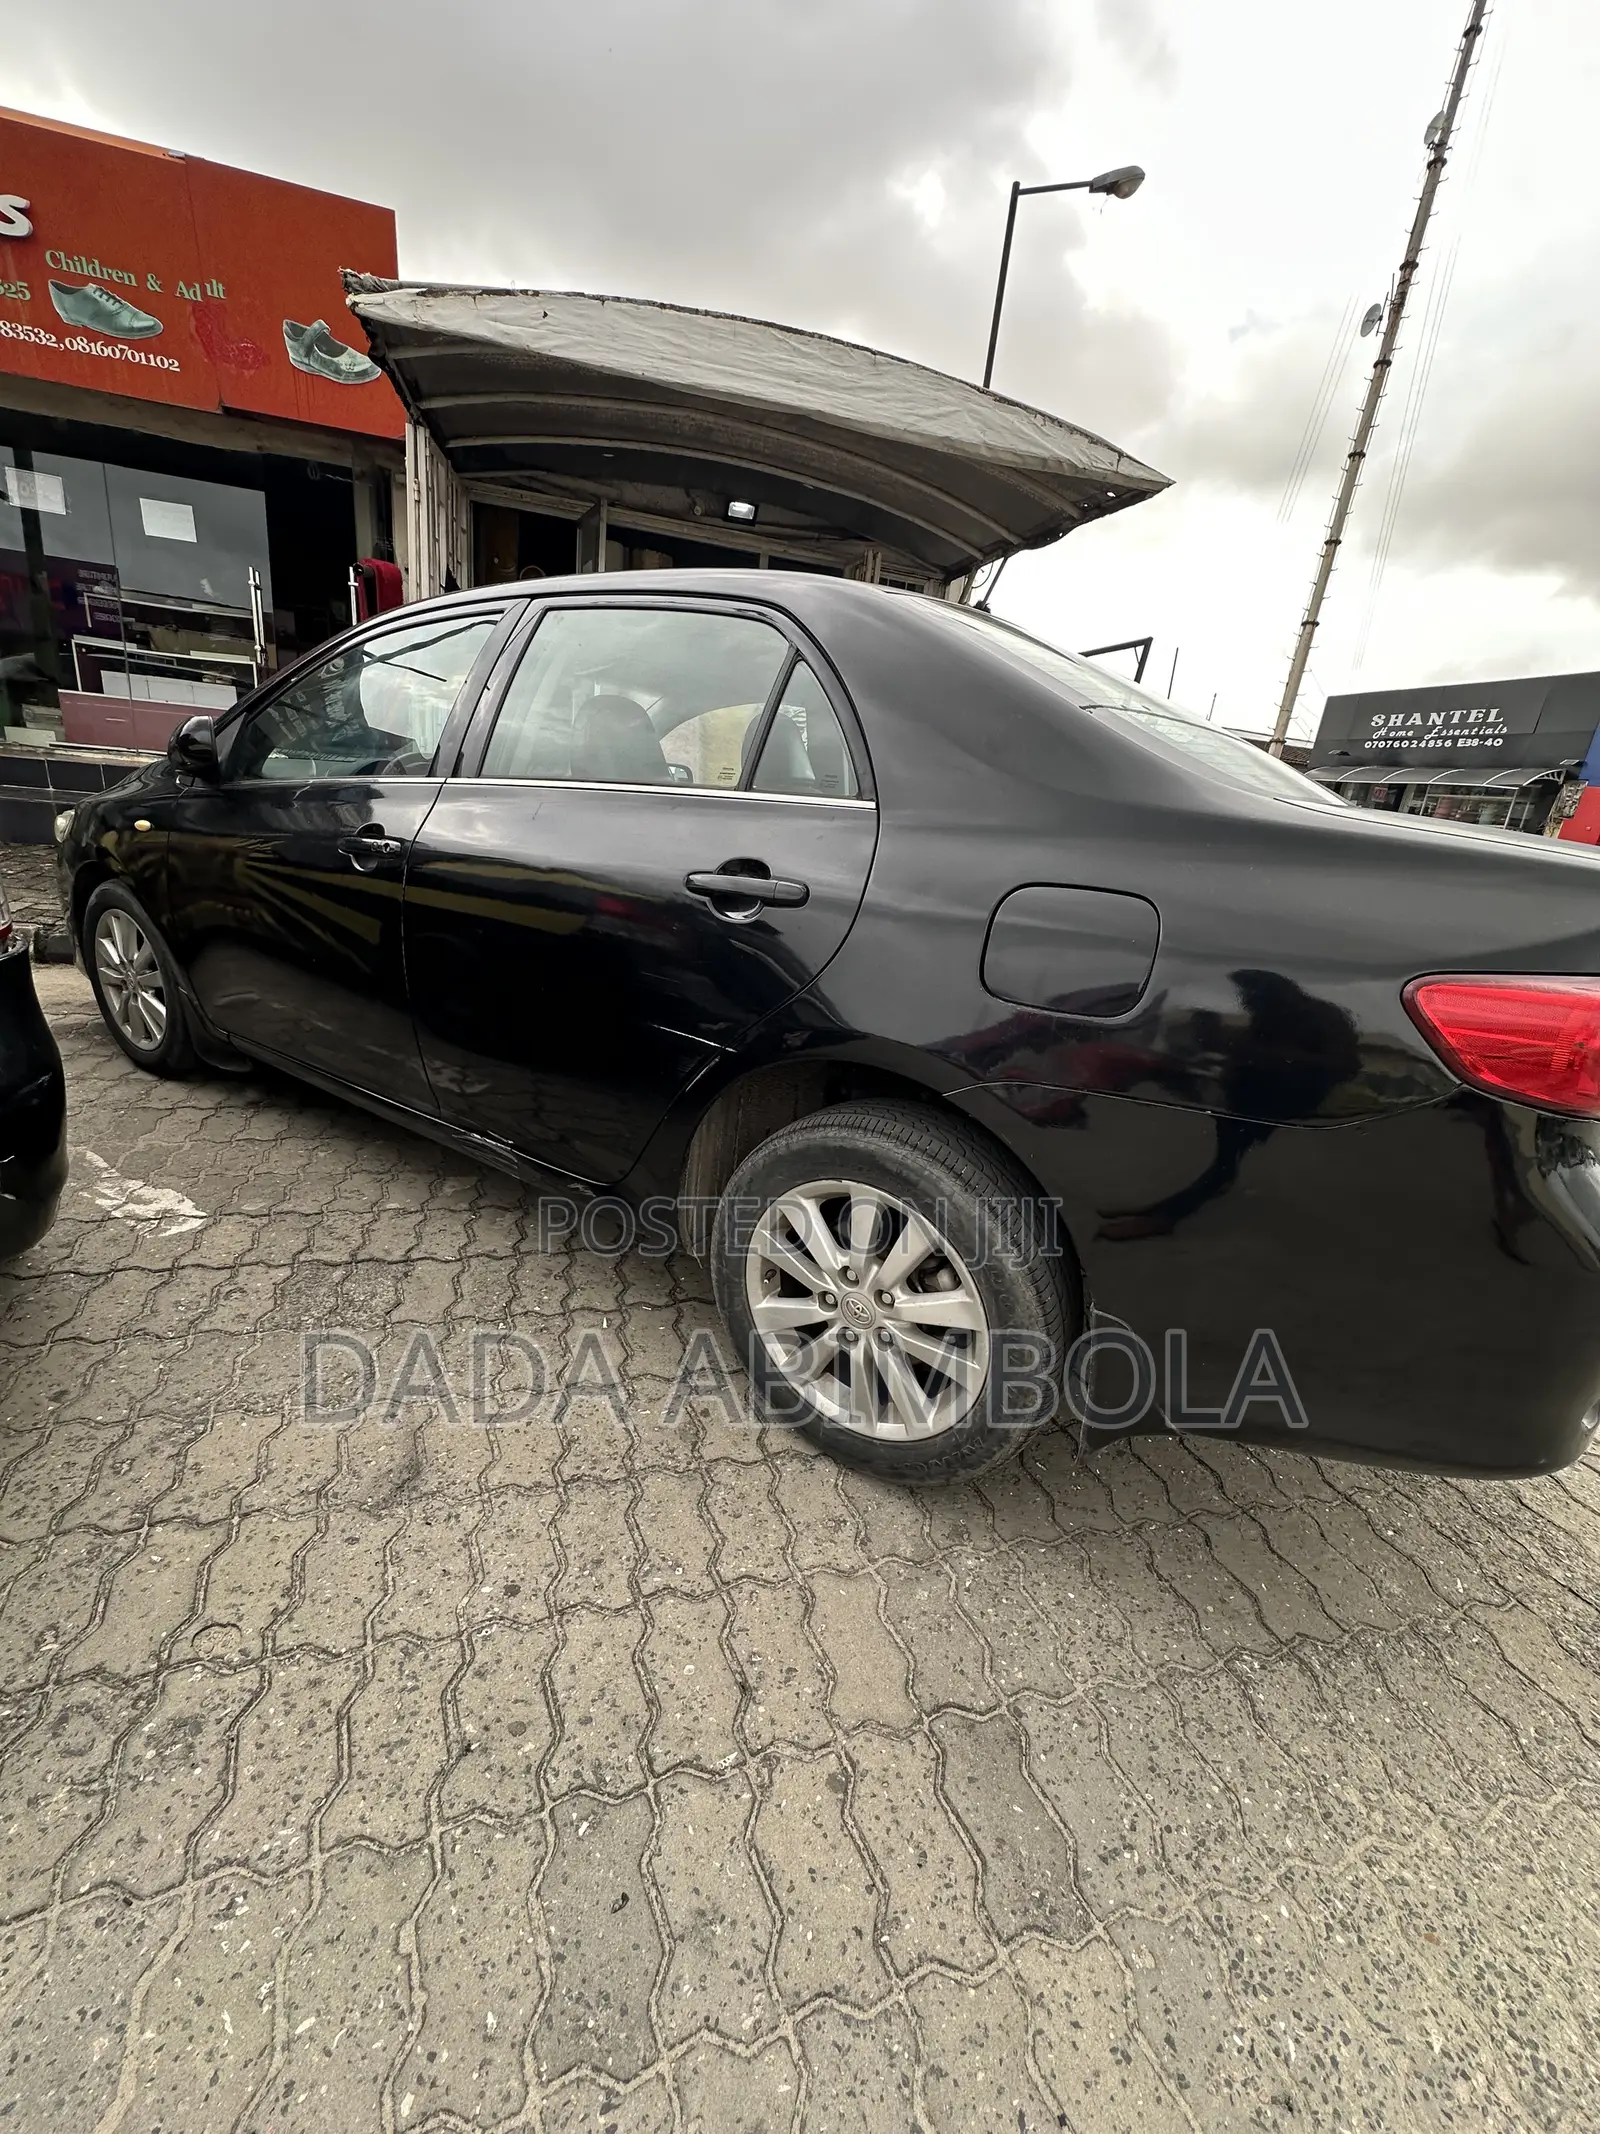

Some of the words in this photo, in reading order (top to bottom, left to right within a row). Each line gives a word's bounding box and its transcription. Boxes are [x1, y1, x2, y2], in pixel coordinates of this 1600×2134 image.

[45, 249, 138, 287] Children
[146, 272, 164, 293] &
[1371, 708, 1503, 726] SHANTEL
[1372, 726, 1415, 739] Home
[1424, 724, 1507, 739] Essentials
[1364, 738, 1453, 749] 07076024856
